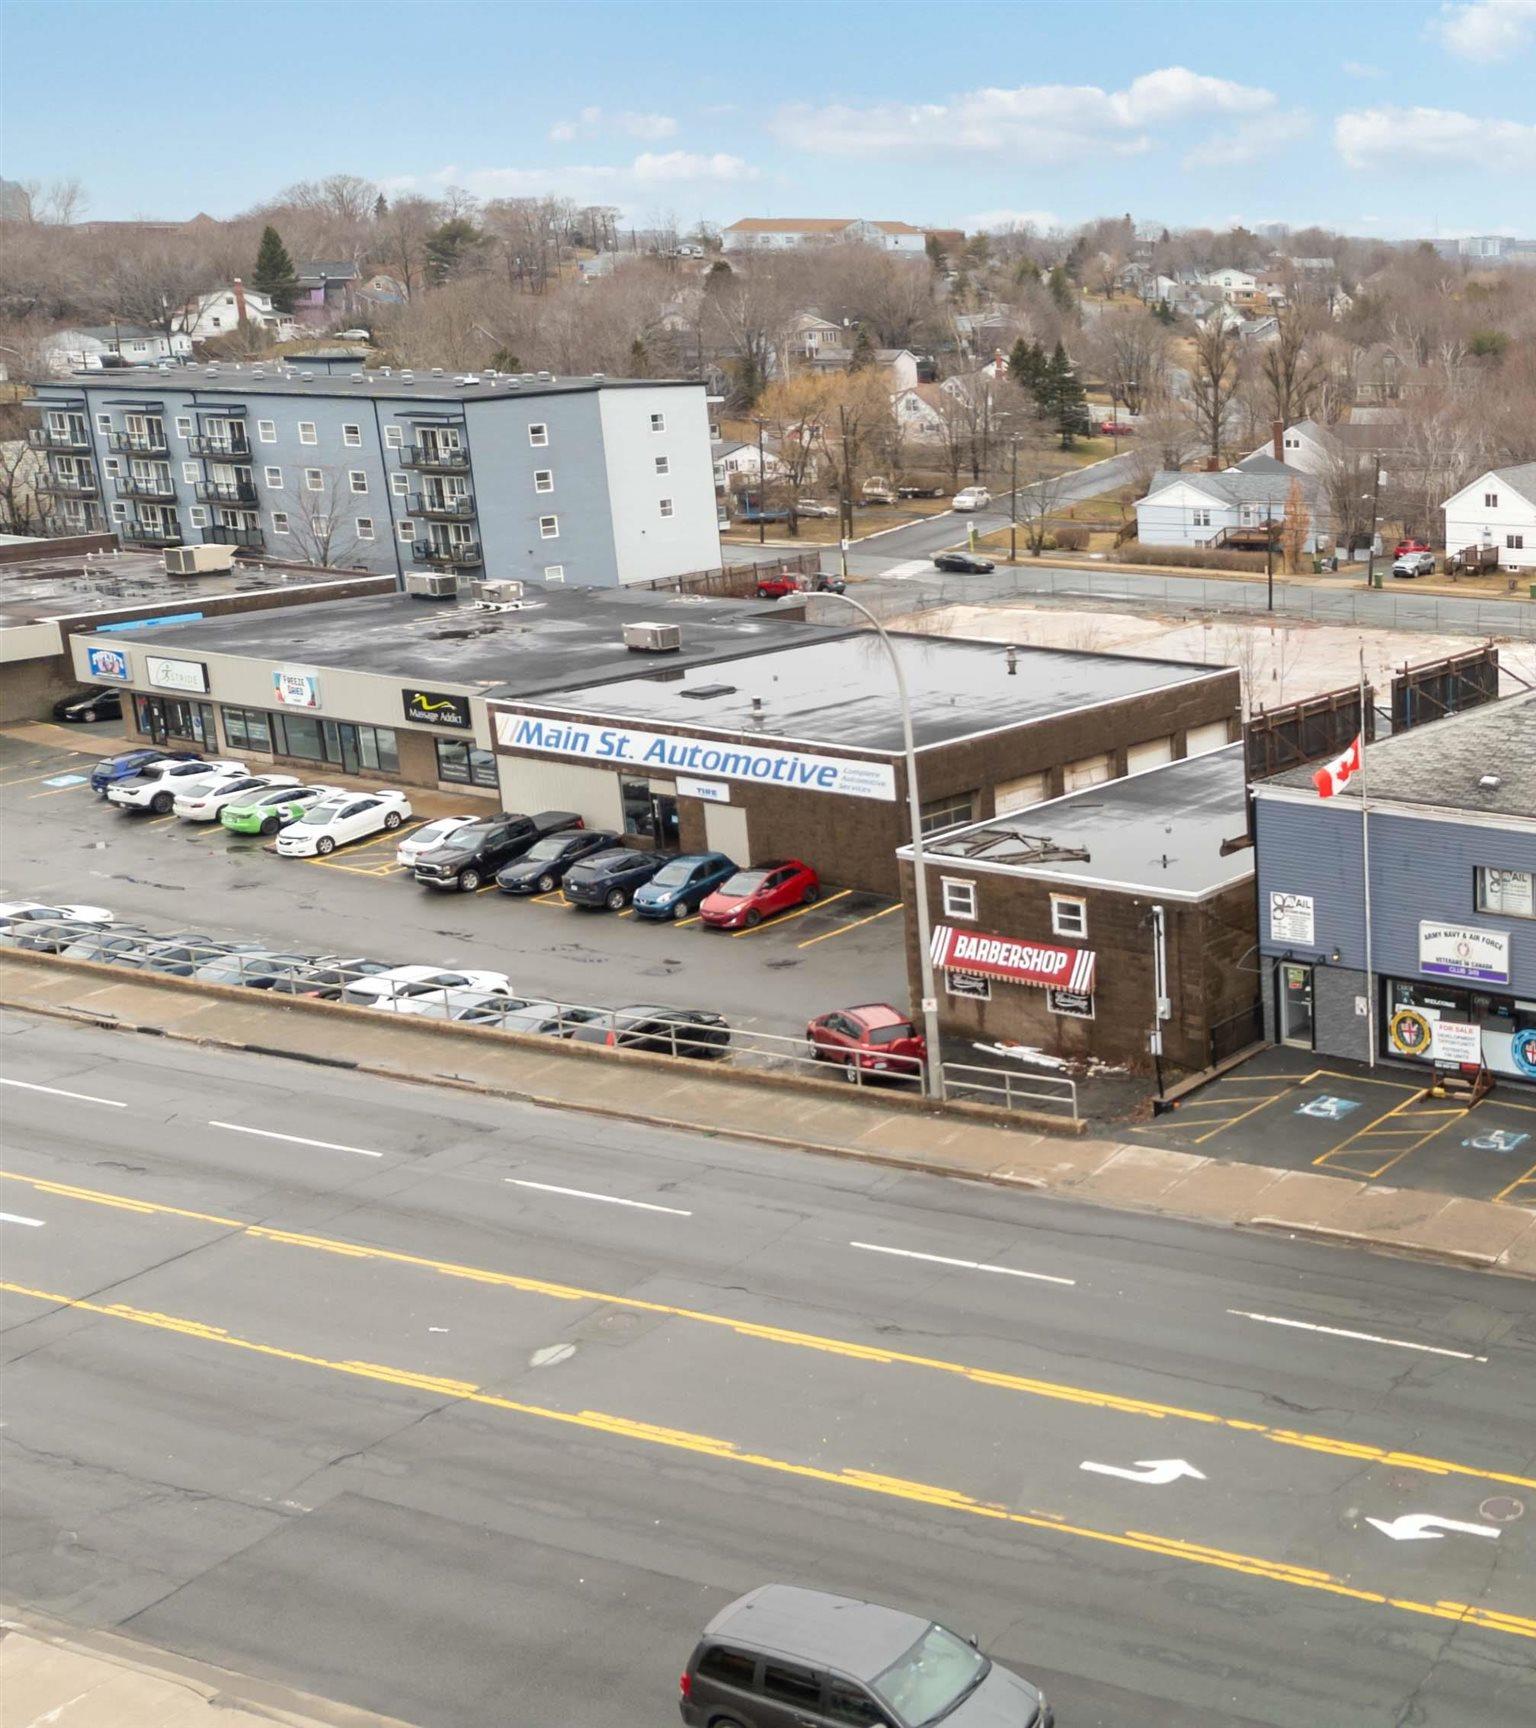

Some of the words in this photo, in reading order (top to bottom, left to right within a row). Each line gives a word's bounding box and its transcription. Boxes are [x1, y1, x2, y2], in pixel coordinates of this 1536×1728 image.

[409, 707, 438, 722] Massage
[440, 711, 462, 724] Addict
[515, 720, 590, 753] Main
[596, 731, 634, 759] St.
[643, 738, 838, 788] Automotive
[839, 782, 872, 794] Services
[841, 775, 887, 788] Automotive
[695, 786, 718, 797] TIRE
[1424, 931, 1442, 940] ARMY
[1443, 930, 1461, 938] NAVY
[1469, 933, 1480, 942] AIR
[1481, 936, 1503, 951] FORCE
[953, 934, 1069, 975] BARBERSHOP
[1435, 956, 1463, 966] VETERANS
[1471, 961, 1493, 969] CANADA
